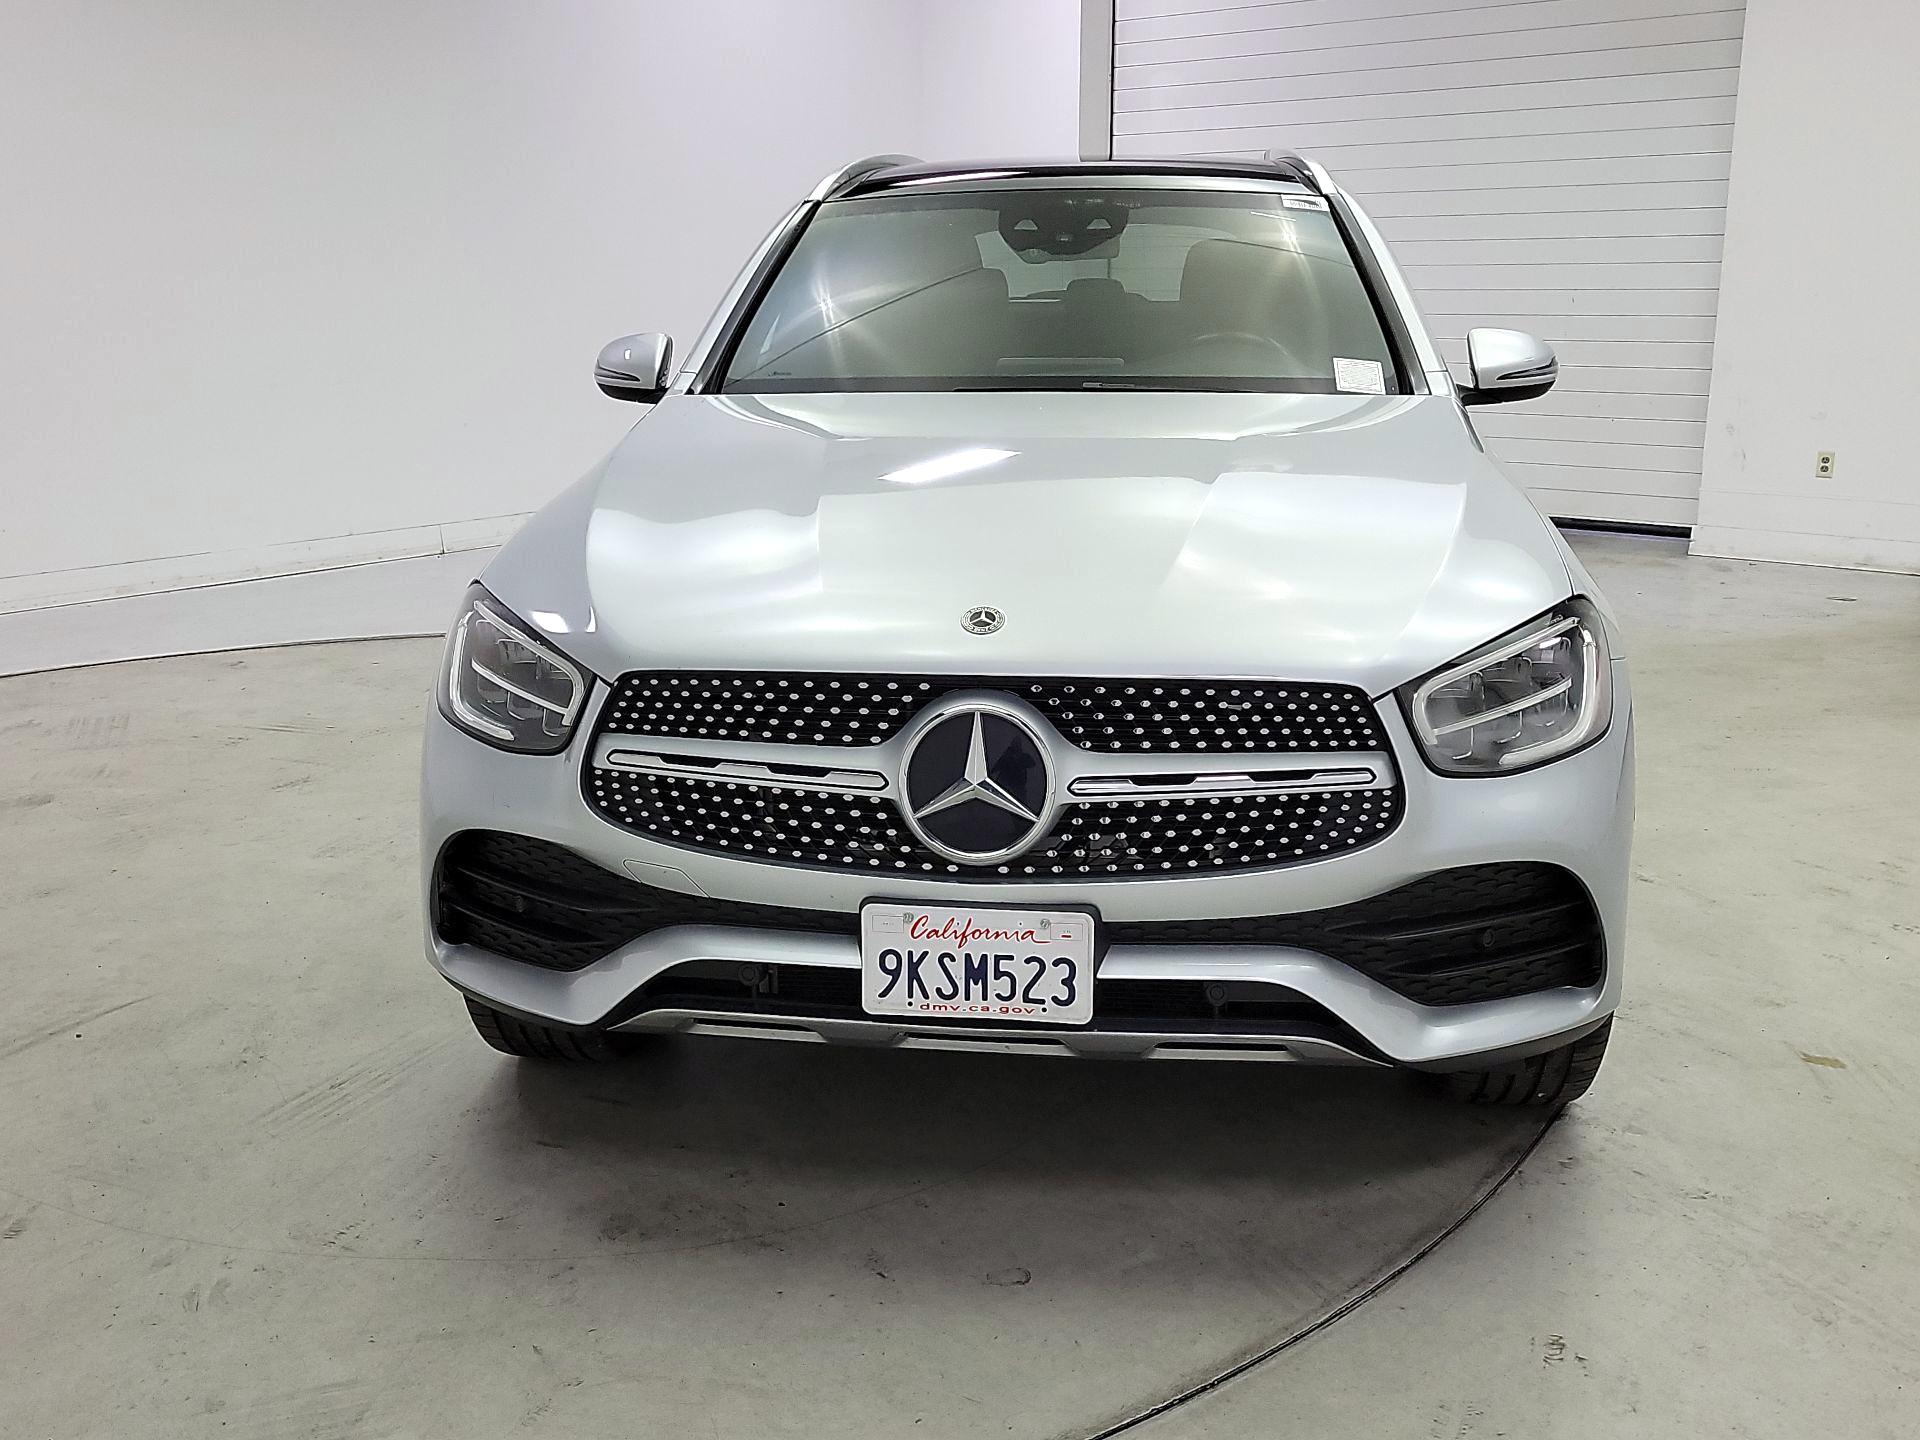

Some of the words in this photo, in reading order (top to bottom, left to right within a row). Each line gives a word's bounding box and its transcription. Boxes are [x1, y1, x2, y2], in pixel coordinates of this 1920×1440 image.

[910, 915, 1051, 948] California
[877, 949, 1077, 1007] 9KSM523
[919, 1002, 1036, 1015] dmv.ca.gov
